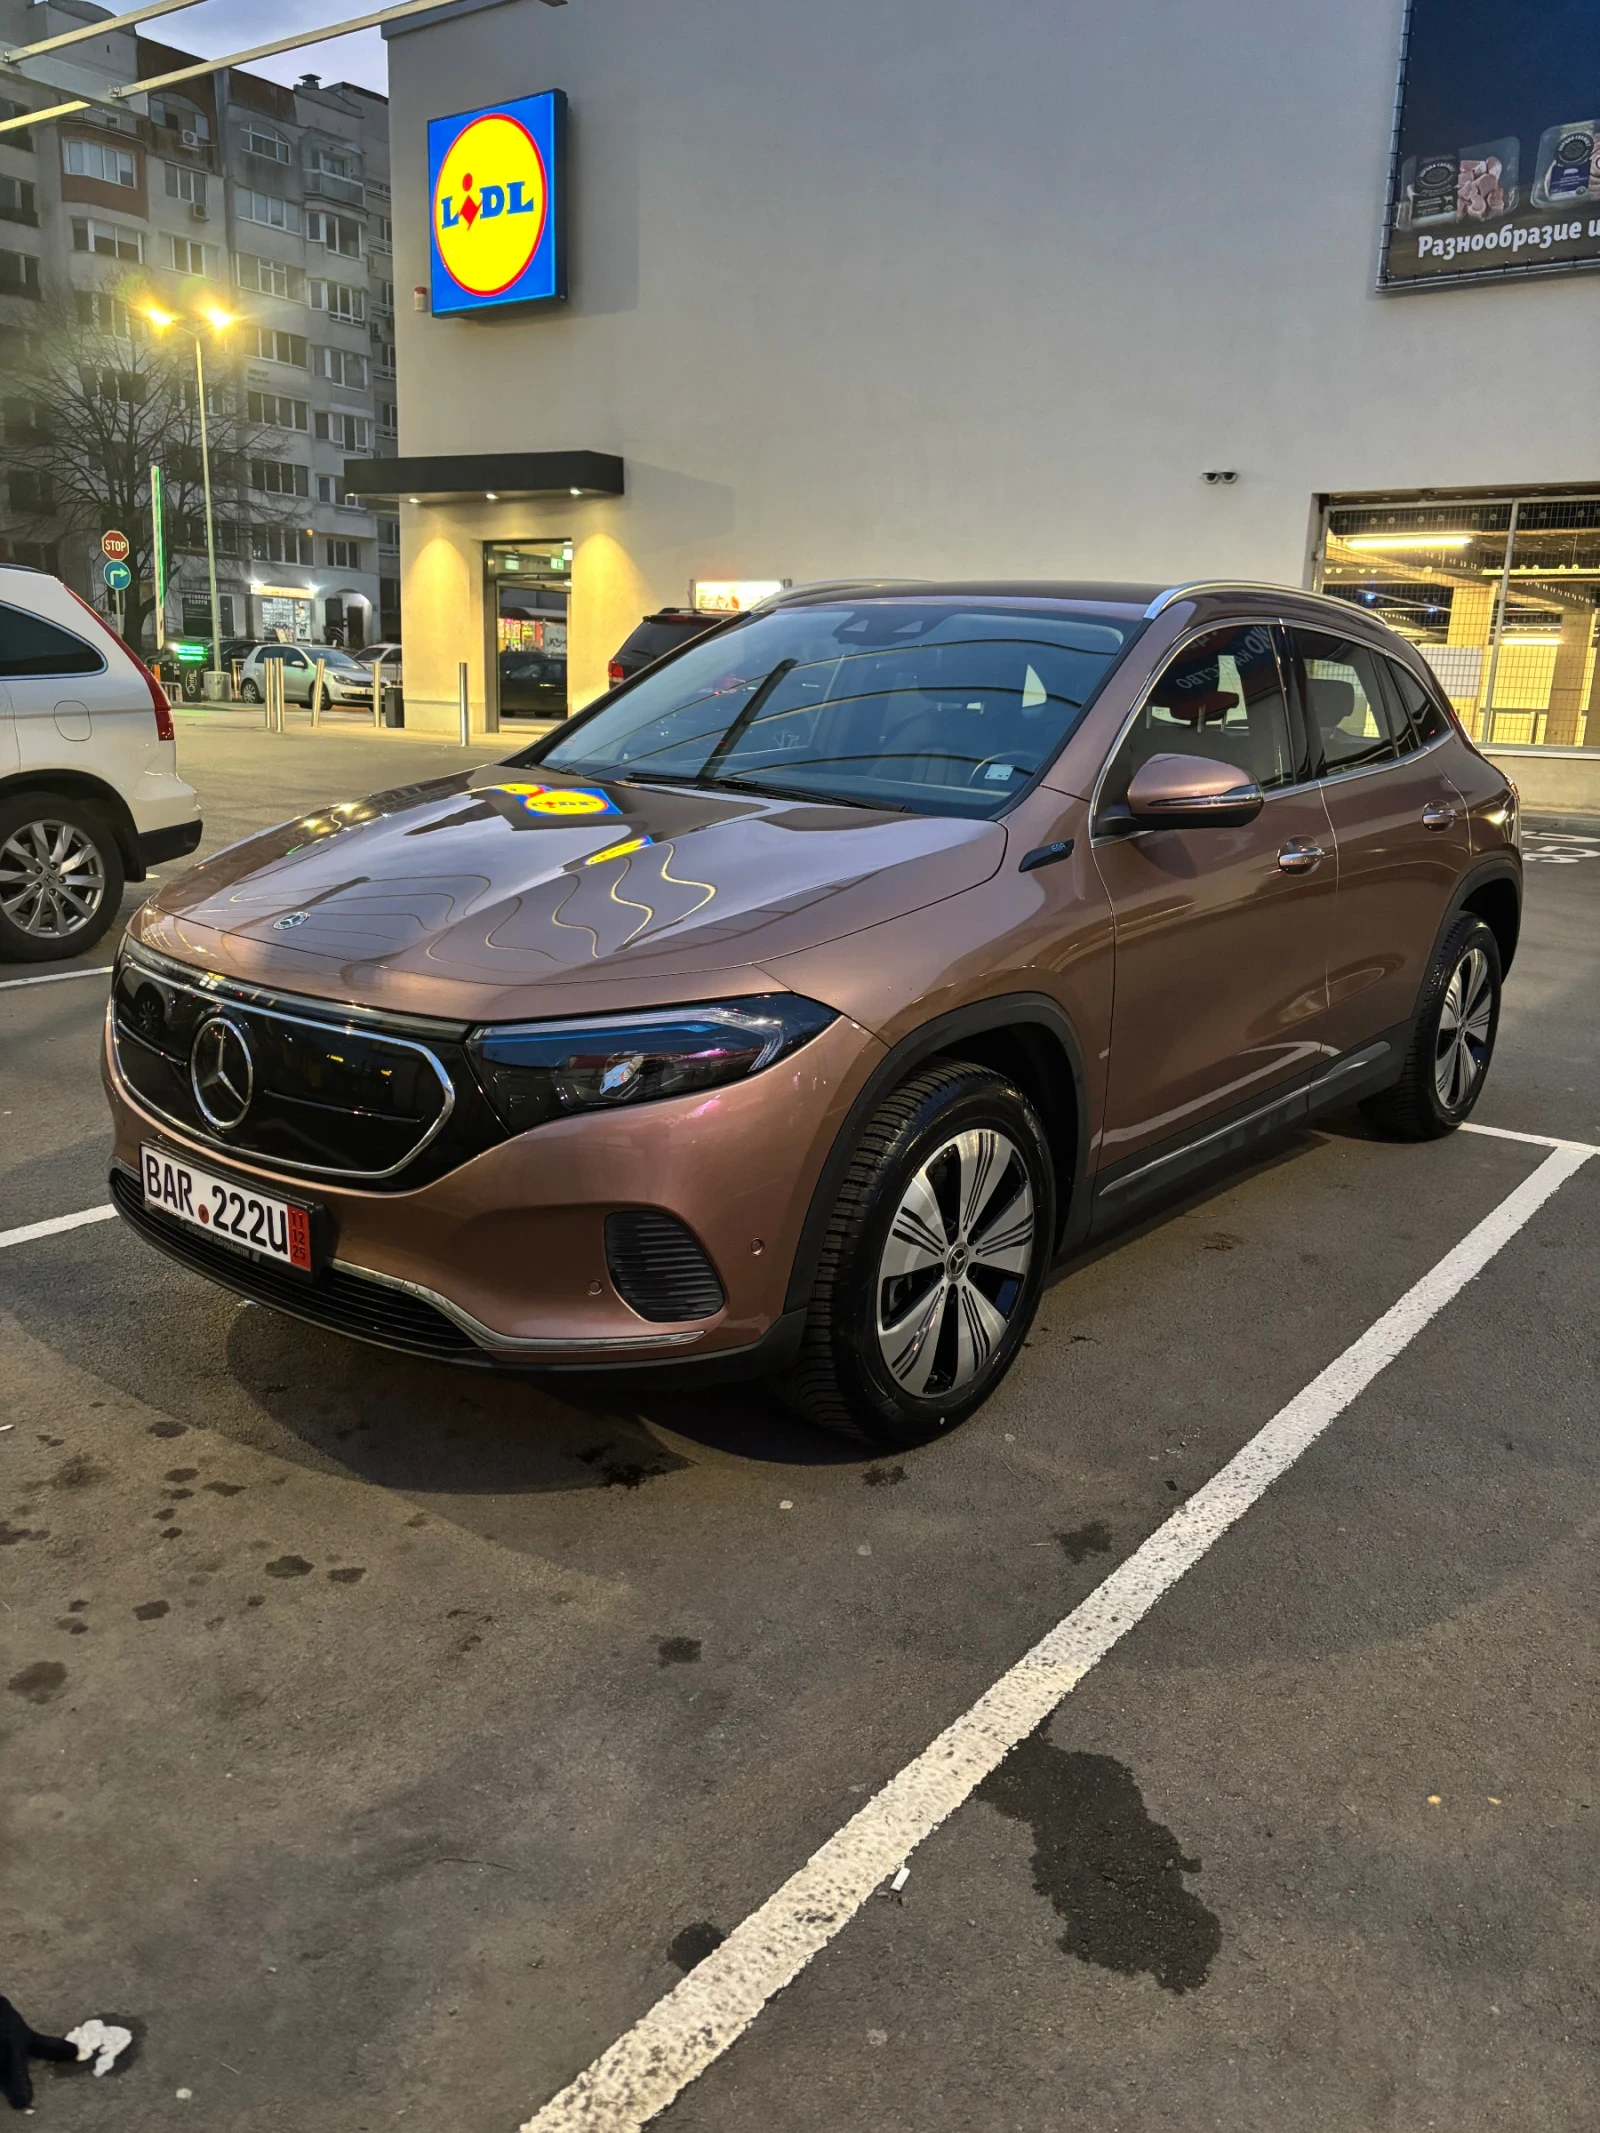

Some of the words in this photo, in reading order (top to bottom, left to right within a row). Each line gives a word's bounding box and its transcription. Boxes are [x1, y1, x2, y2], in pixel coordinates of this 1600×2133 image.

[1417, 221, 1582, 261] Разнообразие
[105, 540, 126, 552] STOP
[145, 1153, 195, 1218] BAR
[211, 1185, 289, 1255] 222U
[291, 1210, 304, 1228] 11
[291, 1230, 305, 1245] 12
[292, 1245, 306, 1260] 25
